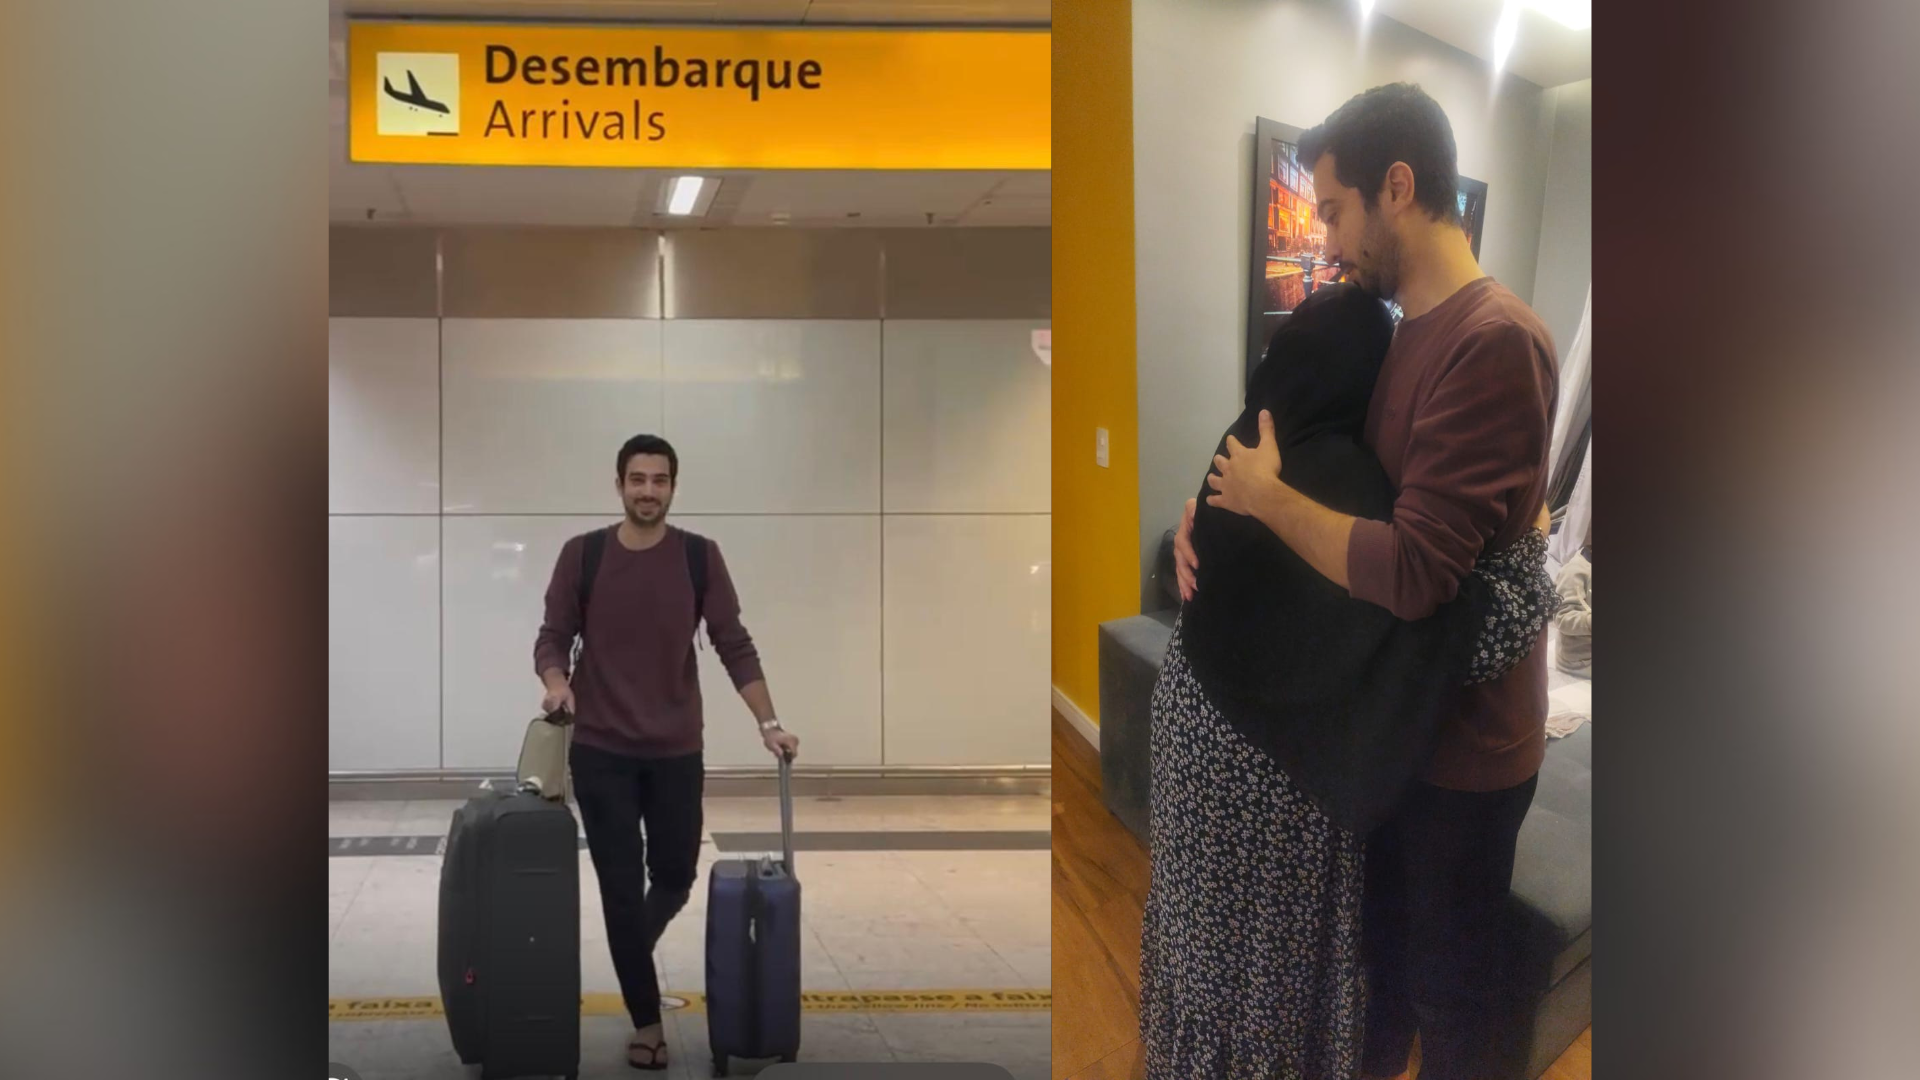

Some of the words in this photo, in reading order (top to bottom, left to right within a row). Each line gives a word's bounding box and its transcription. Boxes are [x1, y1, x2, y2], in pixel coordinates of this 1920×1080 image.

[484, 44, 823, 101] Desembarque
[484, 99, 666, 141] Arrivals
[347, 999, 432, 1010] faixa
[802, 994, 954, 1003] ltrapasse
